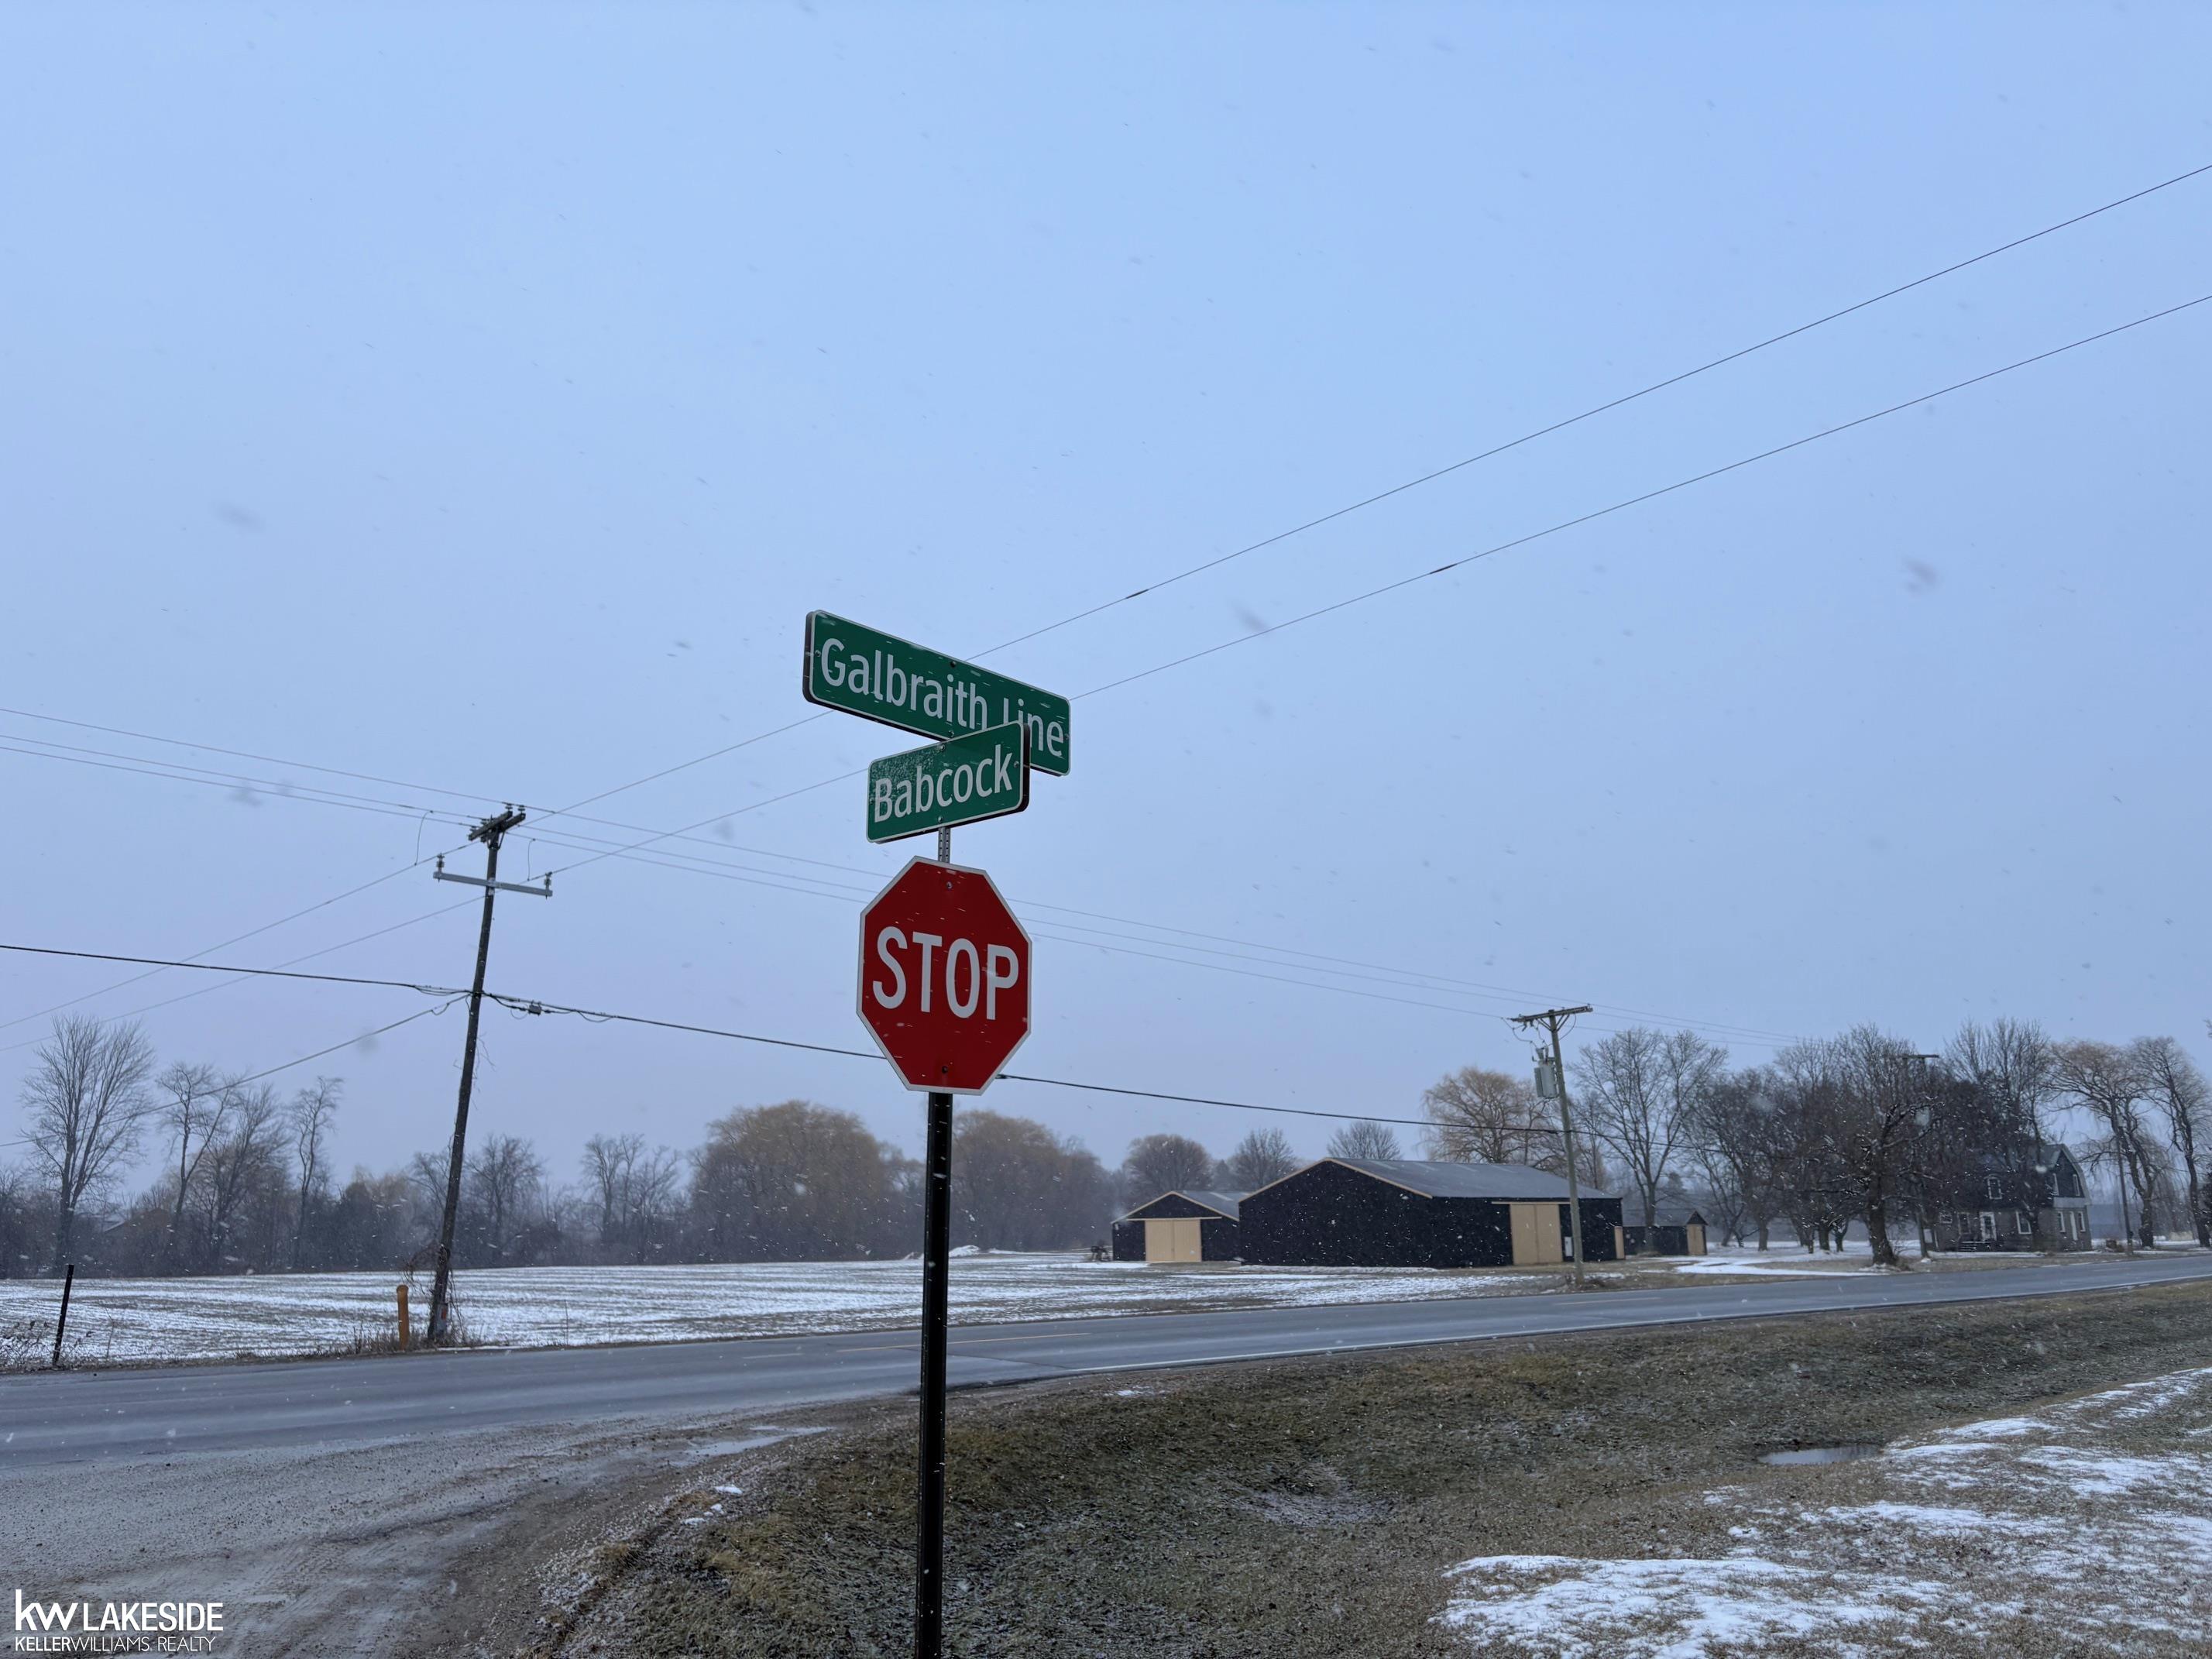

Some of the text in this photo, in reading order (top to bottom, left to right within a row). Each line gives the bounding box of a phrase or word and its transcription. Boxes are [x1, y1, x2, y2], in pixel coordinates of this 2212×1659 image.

[821, 638, 988, 730] Galbraith
[874, 744, 1013, 823] Babcock
[873, 926, 1019, 1020] STOP
